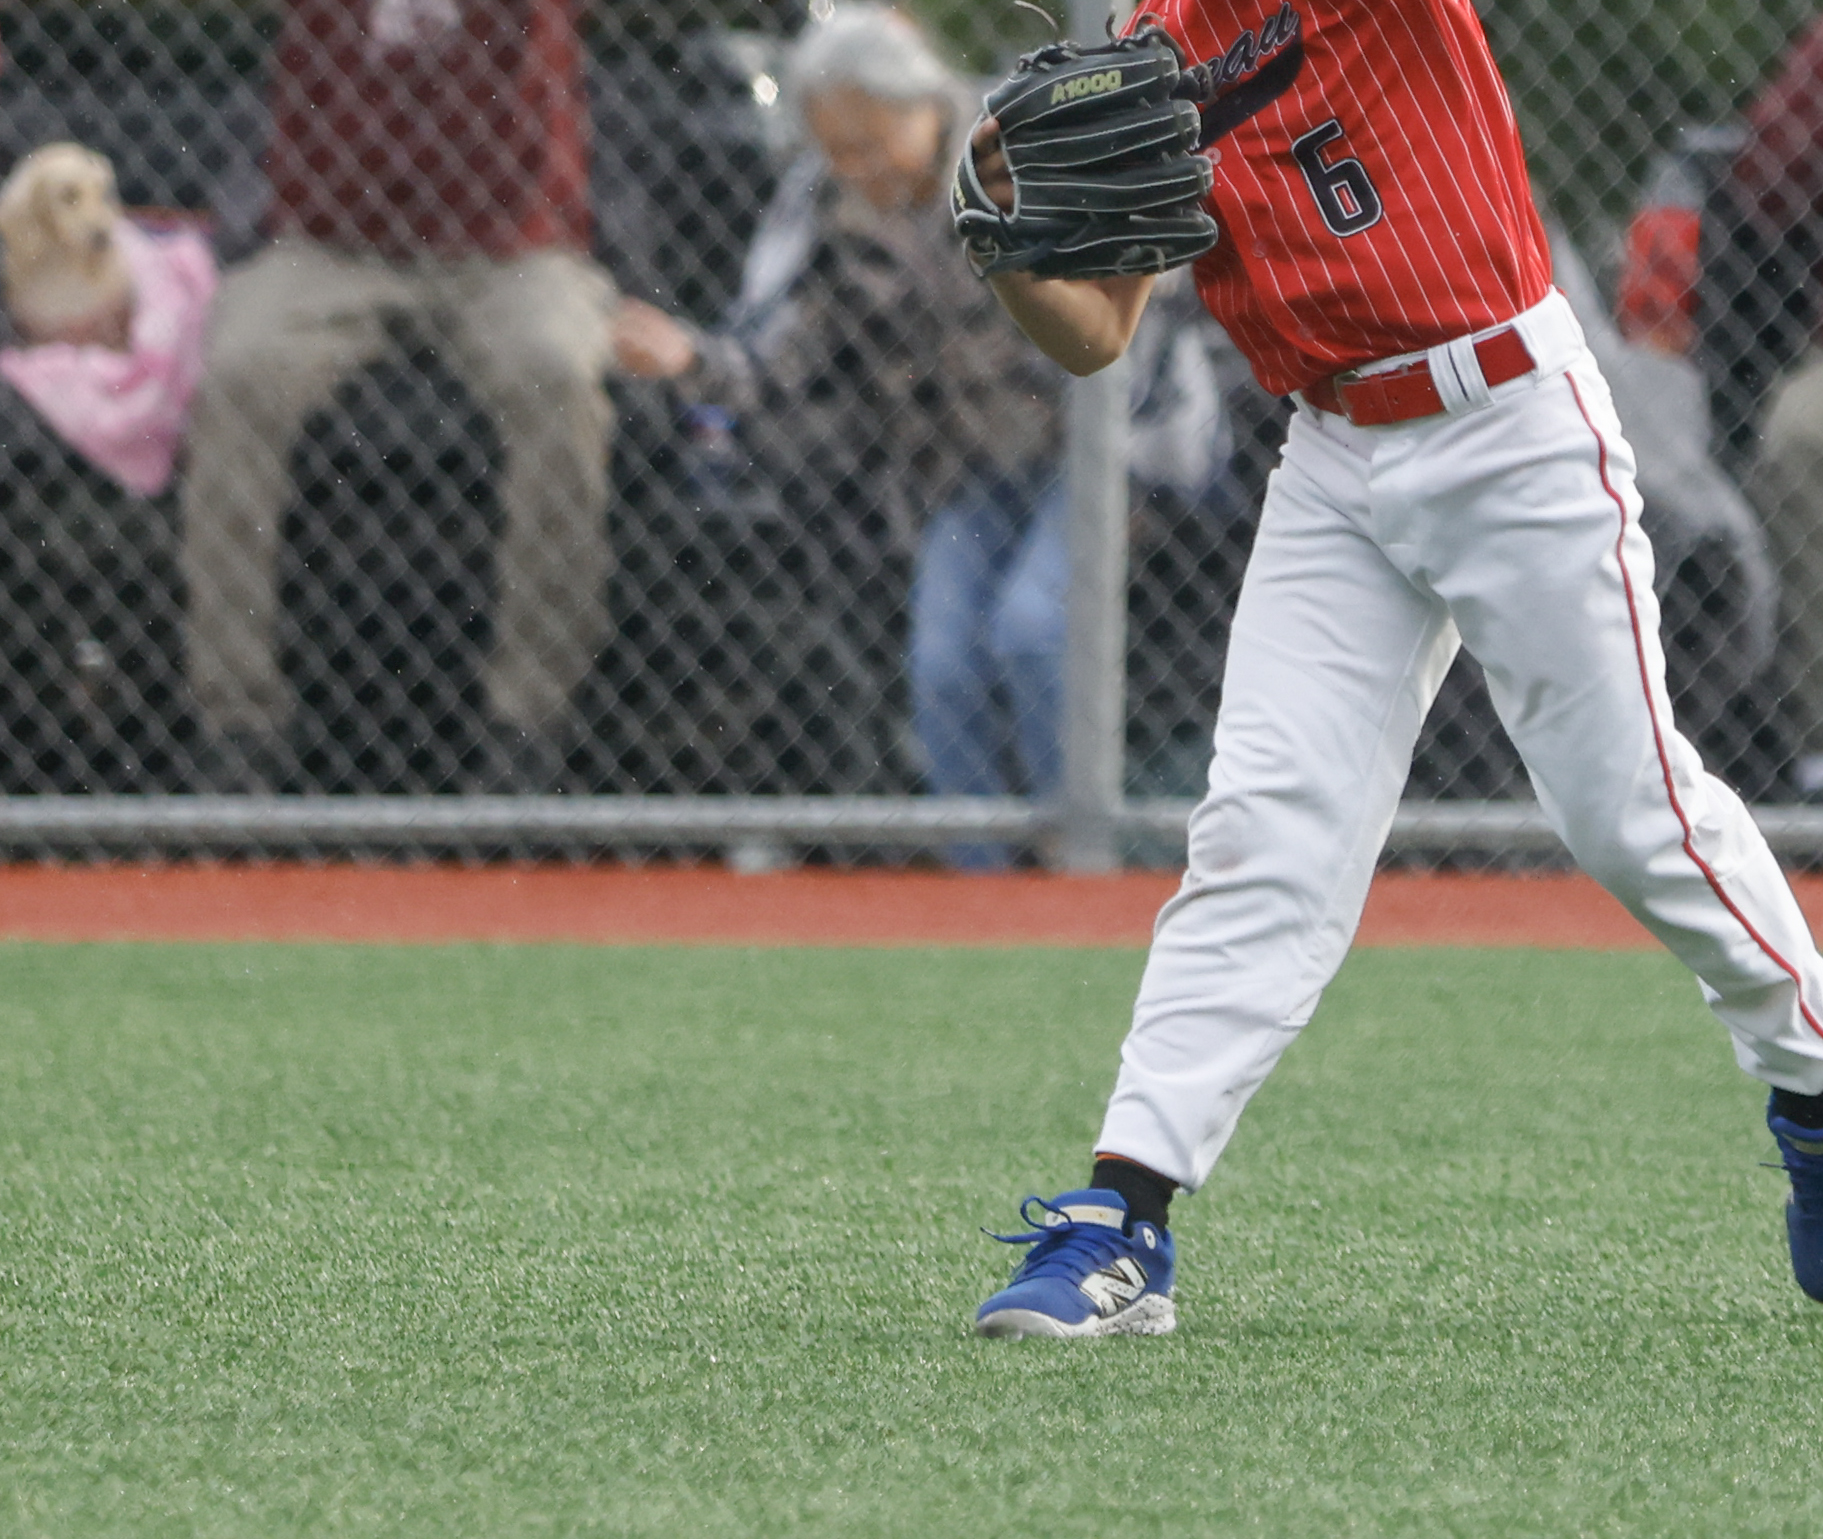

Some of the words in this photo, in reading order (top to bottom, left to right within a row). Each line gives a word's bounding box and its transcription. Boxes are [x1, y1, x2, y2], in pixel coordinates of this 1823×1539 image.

[1050, 69, 1122, 105] A1000
[1206, 1, 1300, 87] eau
[1290, 118, 1382, 237] 6
